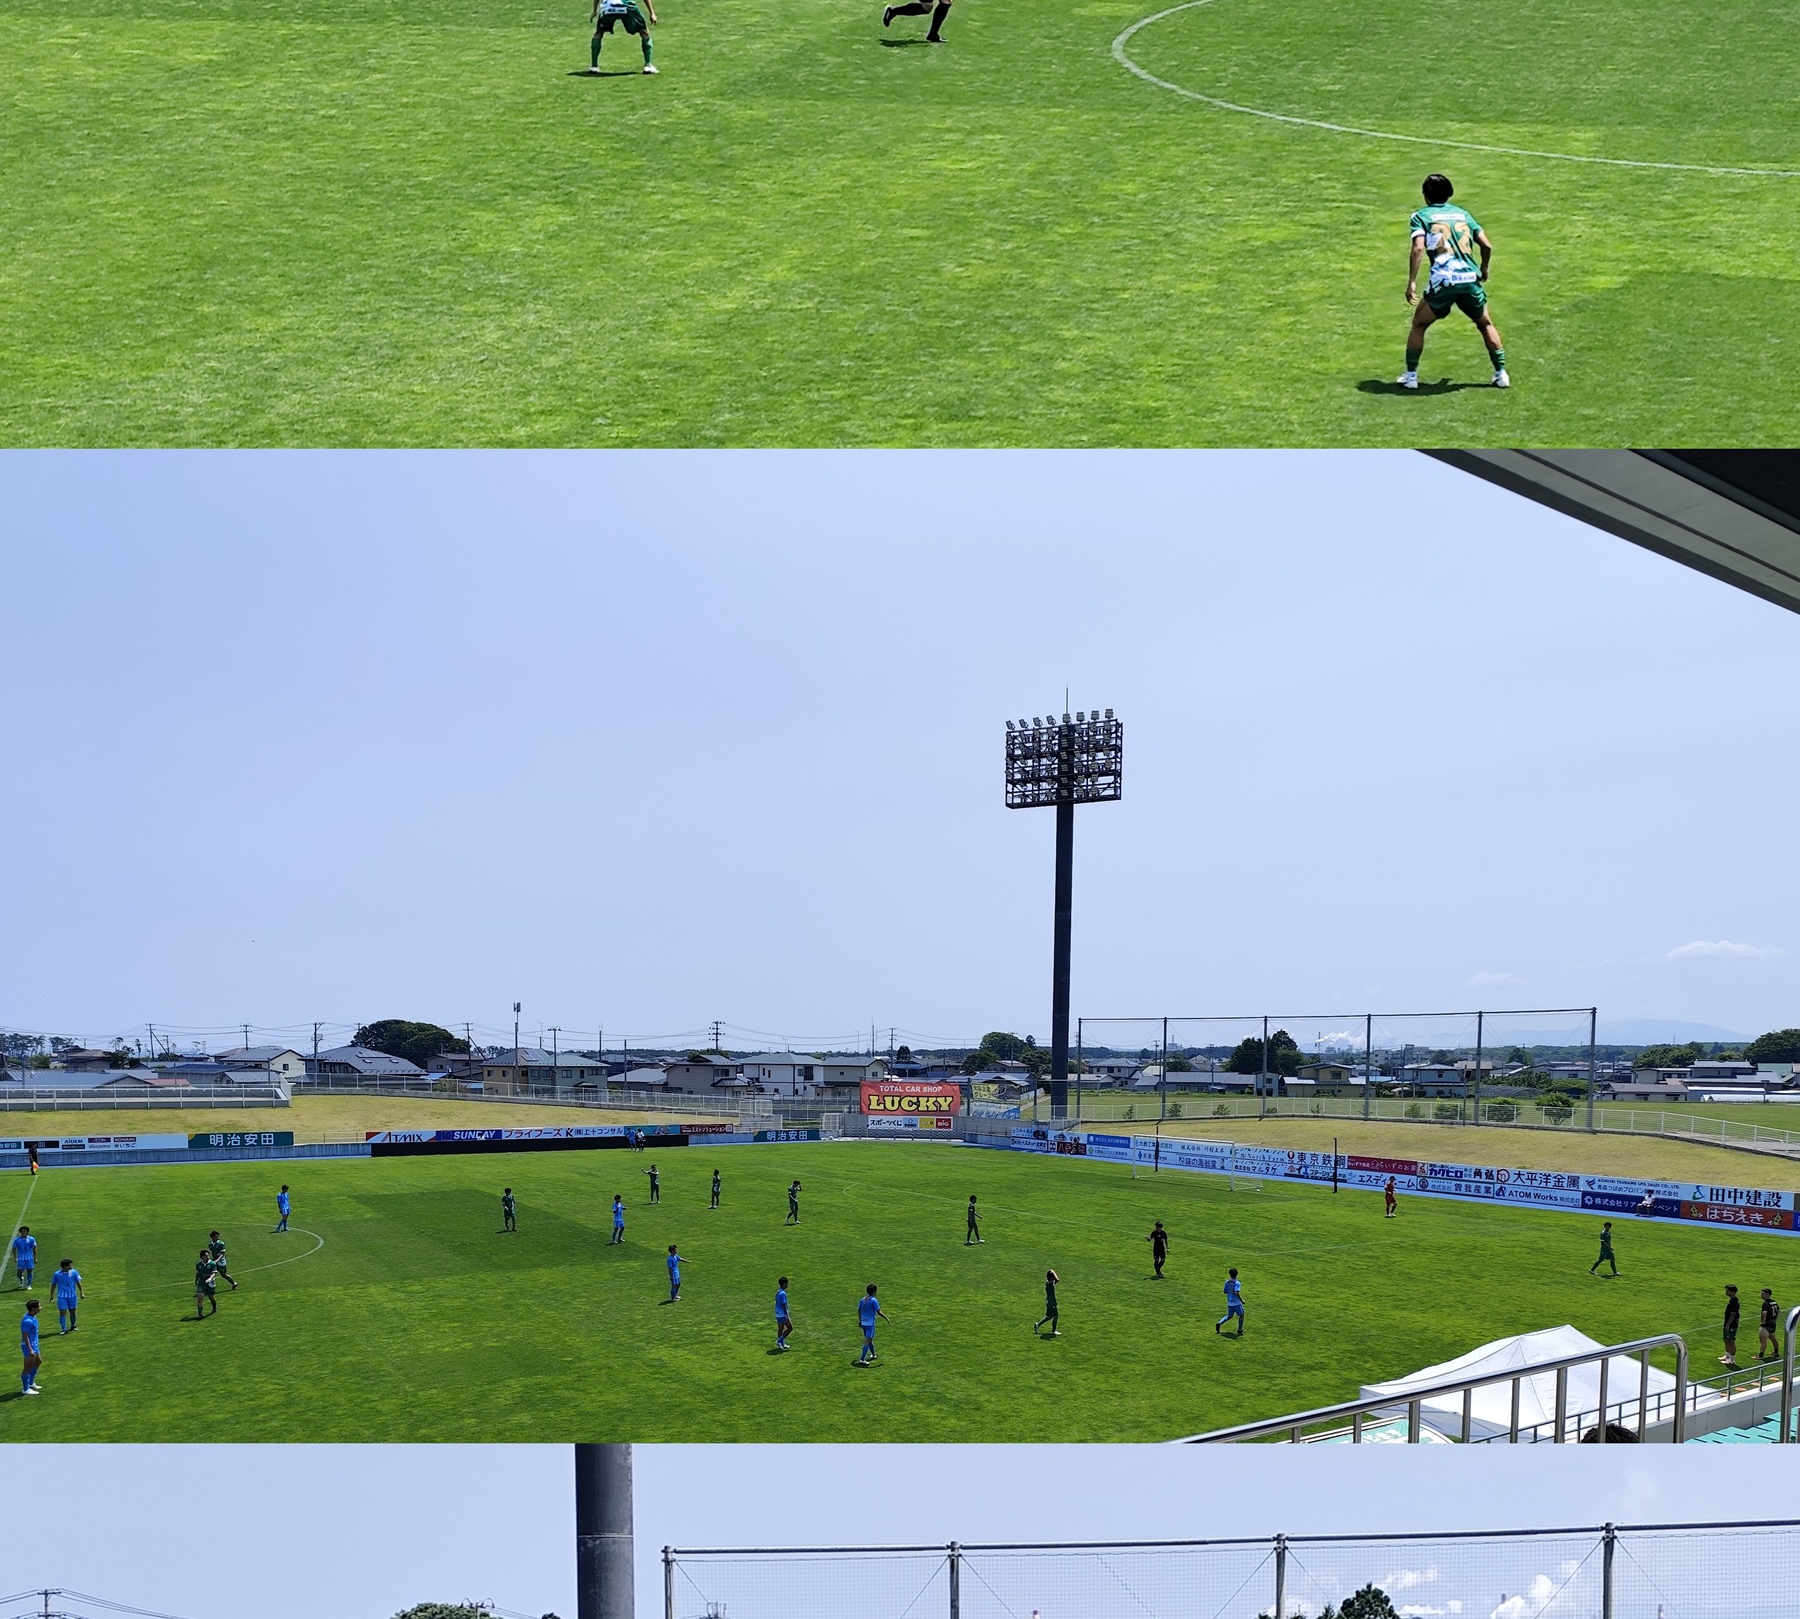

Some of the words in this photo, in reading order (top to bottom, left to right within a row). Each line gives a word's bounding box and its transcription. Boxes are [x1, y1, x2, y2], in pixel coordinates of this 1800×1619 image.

[868, 1095, 953, 1112] LUCKY
[870, 1118, 902, 1128] スポーツくじ
[209, 1133, 275, 1147] 明治安田
[503, 1129, 563, 1139] プライフーズ
[766, 1130, 808, 1142] 明治安田
[1508, 1190, 1532, 1200] ATOM
[1533, 1192, 1558, 1202] Works
[1709, 1186, 1782, 1209] 田中建設
[1705, 1207, 1764, 1224] はちえき
